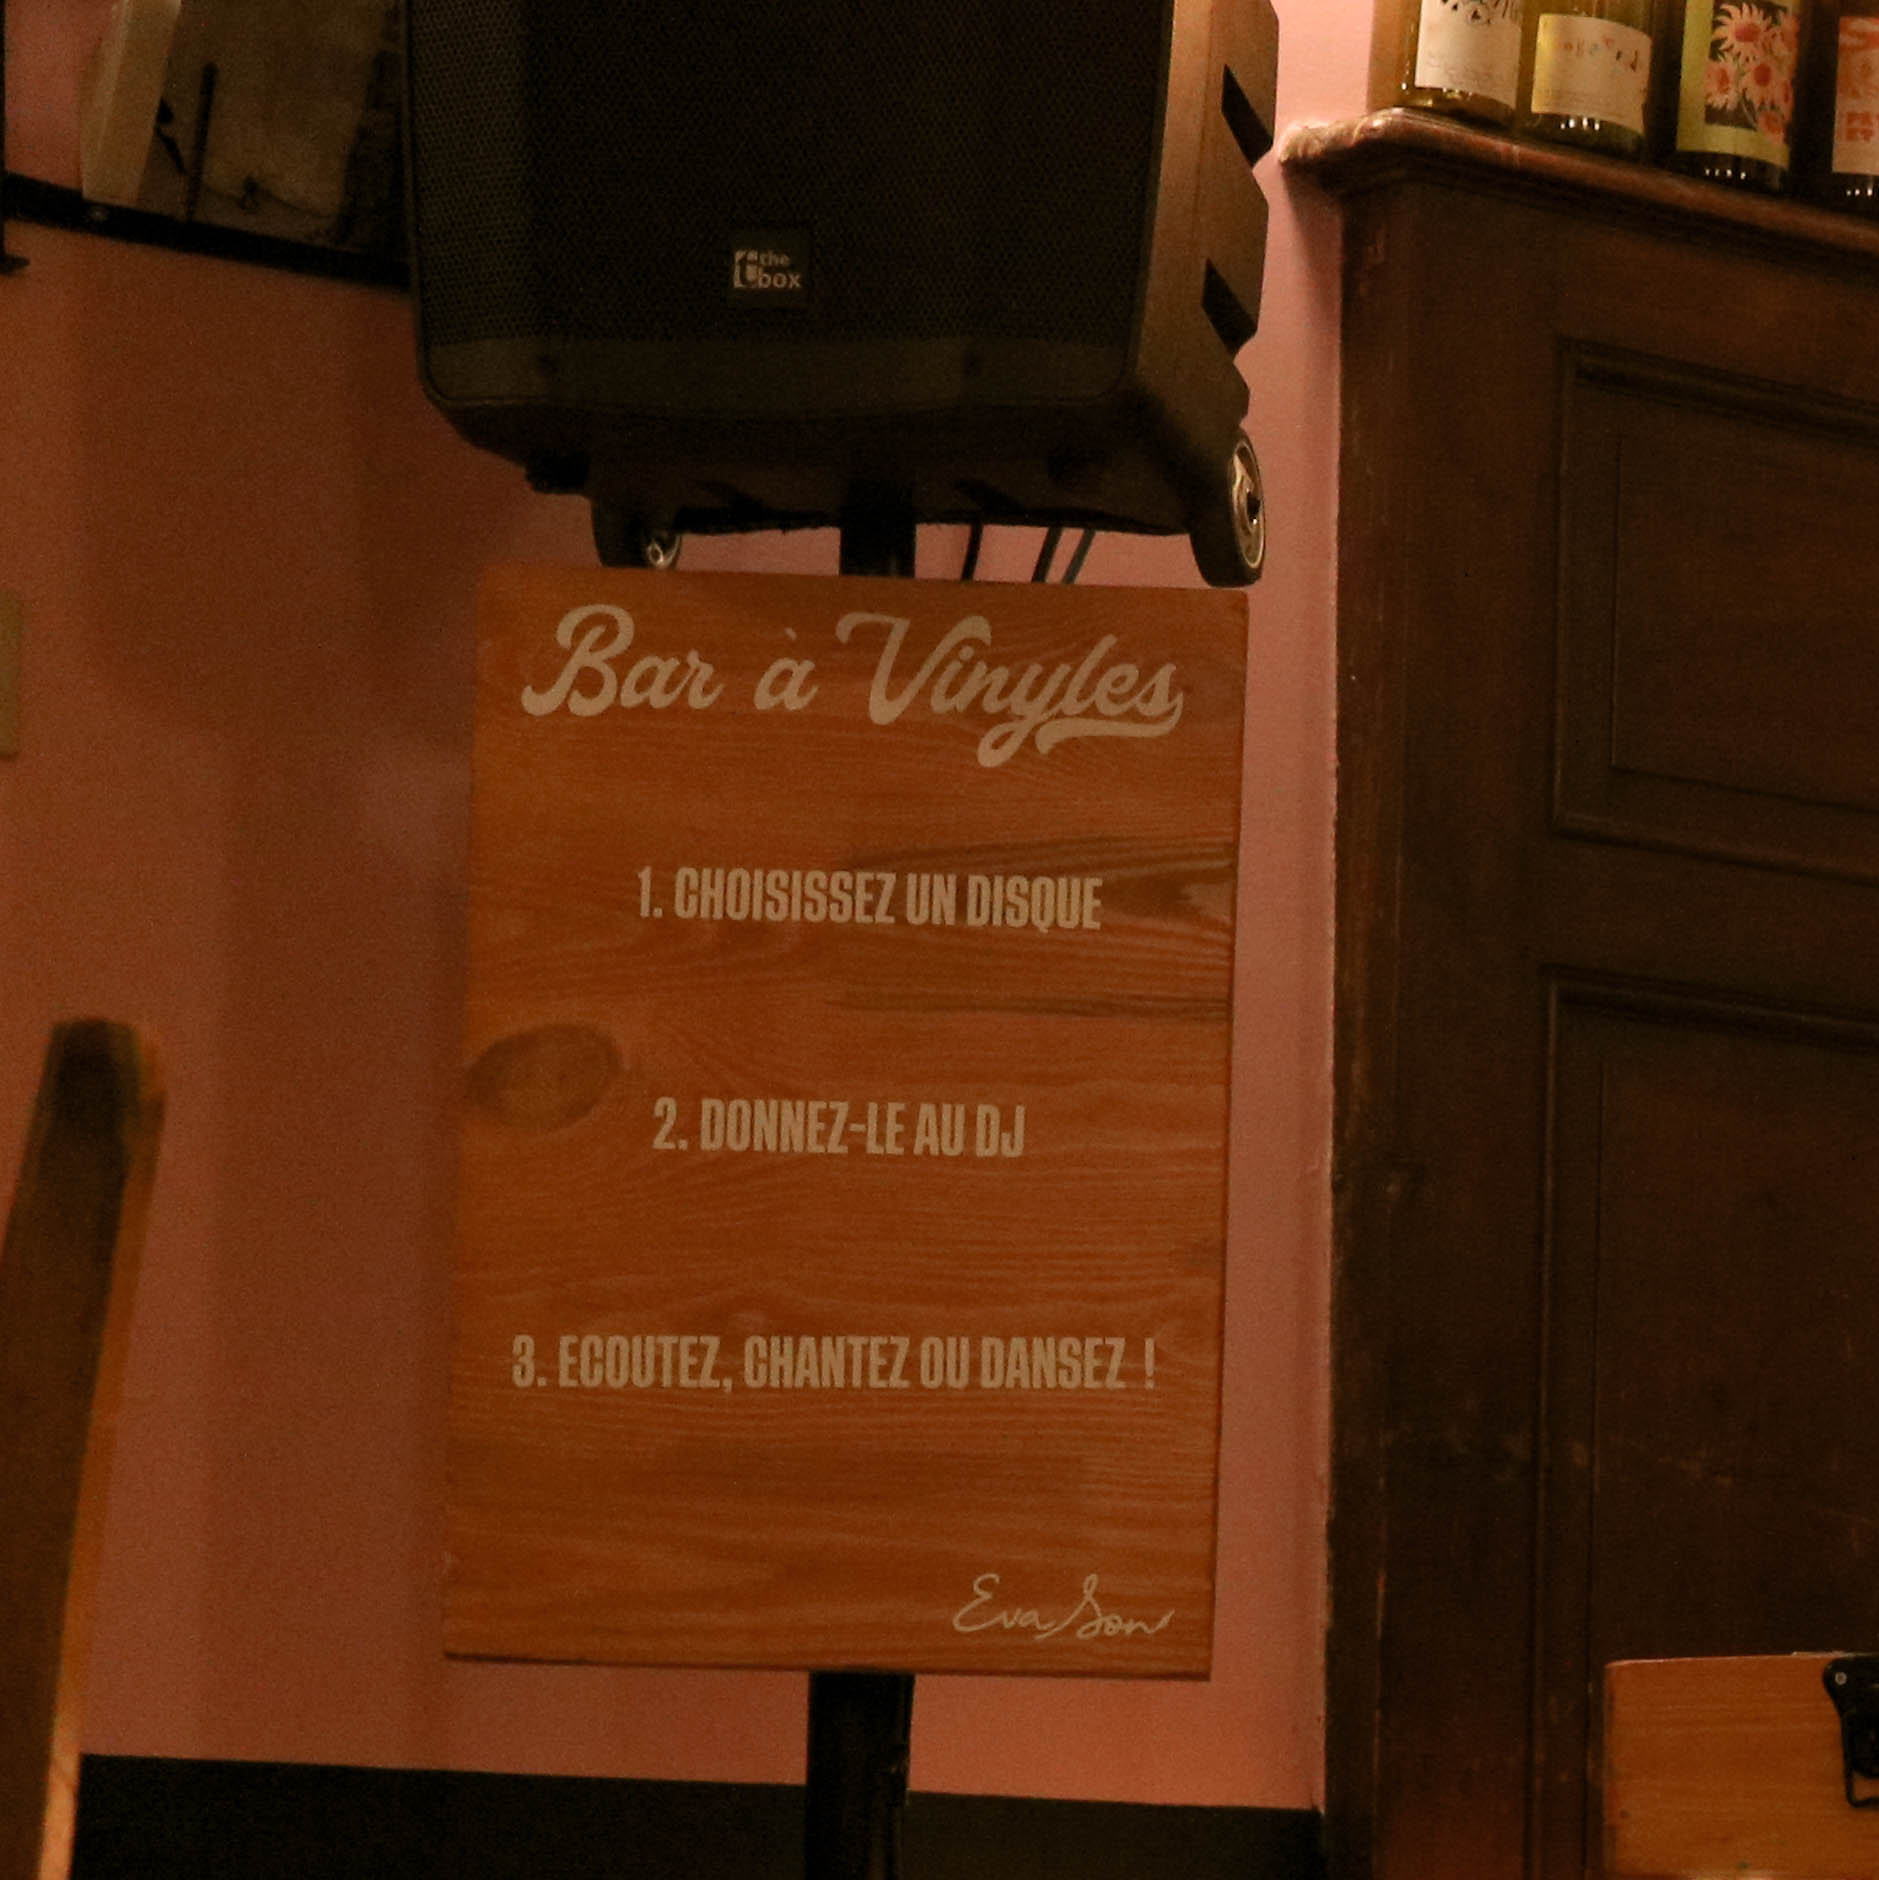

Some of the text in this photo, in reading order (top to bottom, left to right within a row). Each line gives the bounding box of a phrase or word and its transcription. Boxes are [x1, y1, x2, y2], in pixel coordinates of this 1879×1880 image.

[757, 267, 802, 289] box
[521, 603, 1185, 769] Bar à Vinyles
[637, 866, 1104, 935] 1. CHOISISSEZ UN DISQUE
[653, 1096, 1027, 1159] 2. DONNEZ-LE AU DJ
[512, 1335, 548, 1389] 3.
[558, 1335, 734, 1392] ECOUTEZ,
[743, 1336, 912, 1390] CHANTEZ
[920, 1336, 972, 1390] OU
[980, 1337, 1127, 1390] DANSEZ
